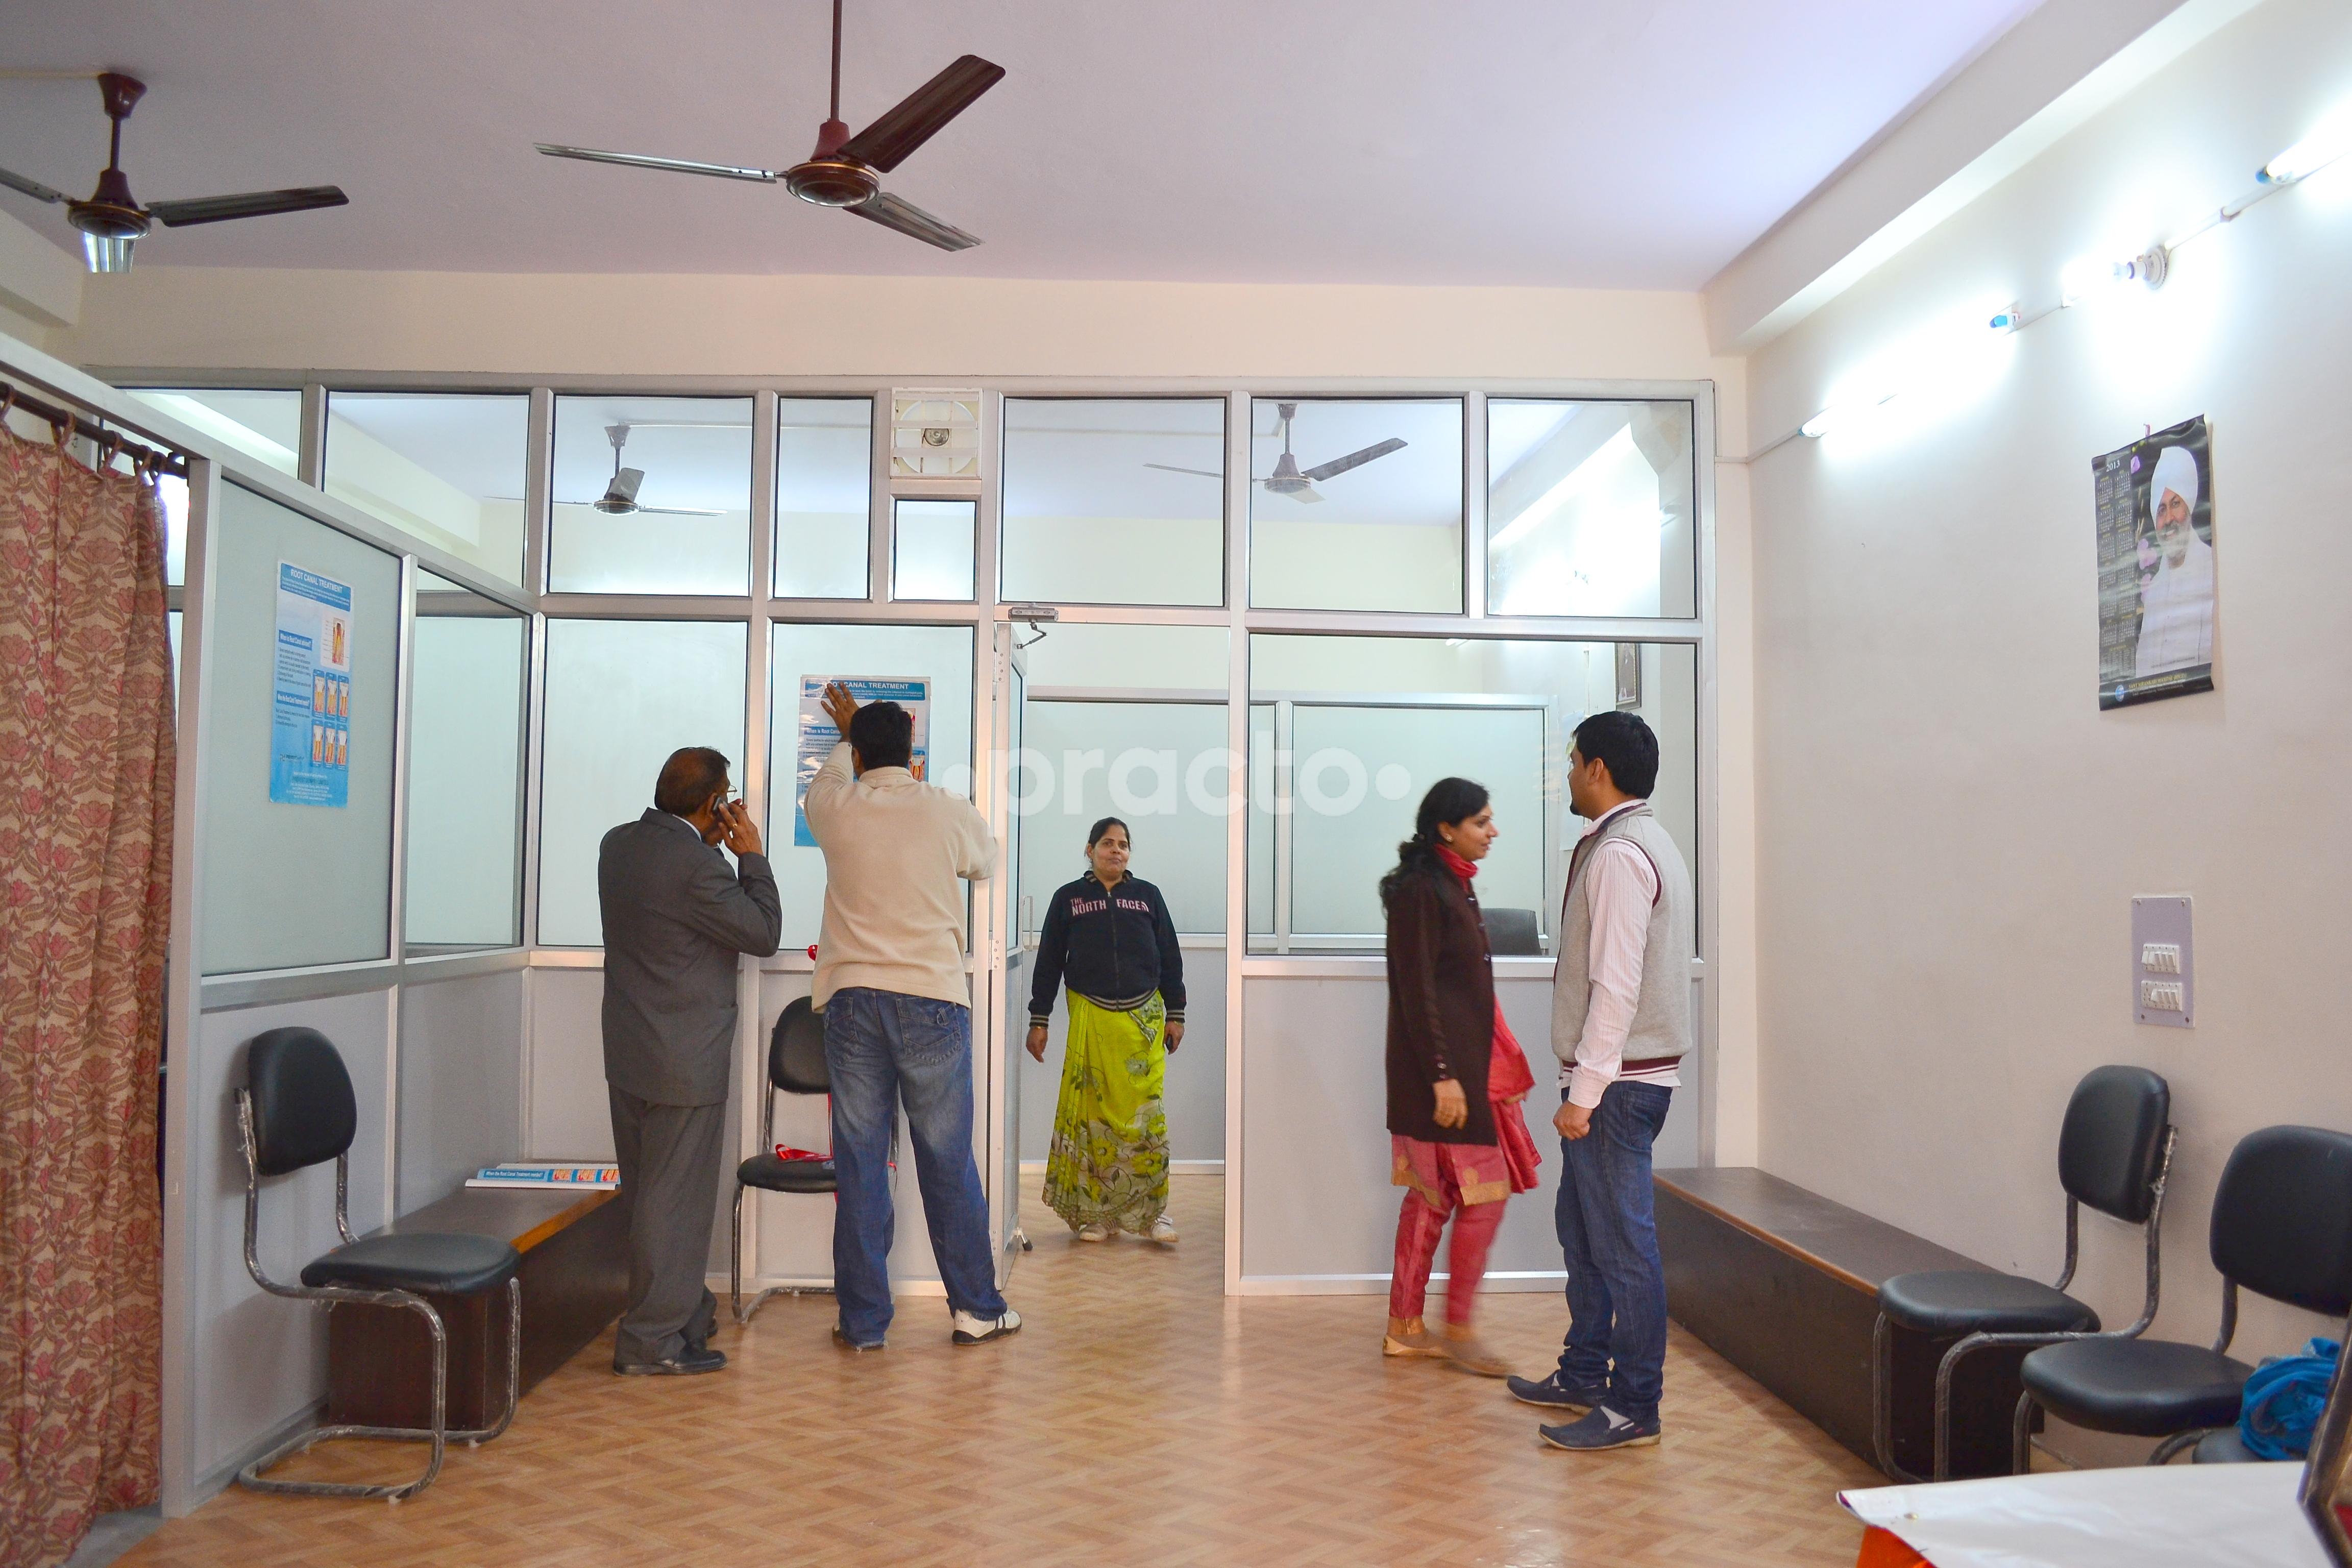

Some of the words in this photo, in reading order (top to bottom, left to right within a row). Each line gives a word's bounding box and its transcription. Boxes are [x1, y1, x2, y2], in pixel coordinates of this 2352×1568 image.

[2106, 460, 2120, 472] 2013
[290, 569, 303, 580] ROOT
[304, 574, 318, 585] CANAL
[318, 579, 342, 593] TREATMENT
[1070, 897, 1083, 905] THE
[1072, 900, 1107, 916] NORTH
[1116, 898, 1141, 910] FACE
